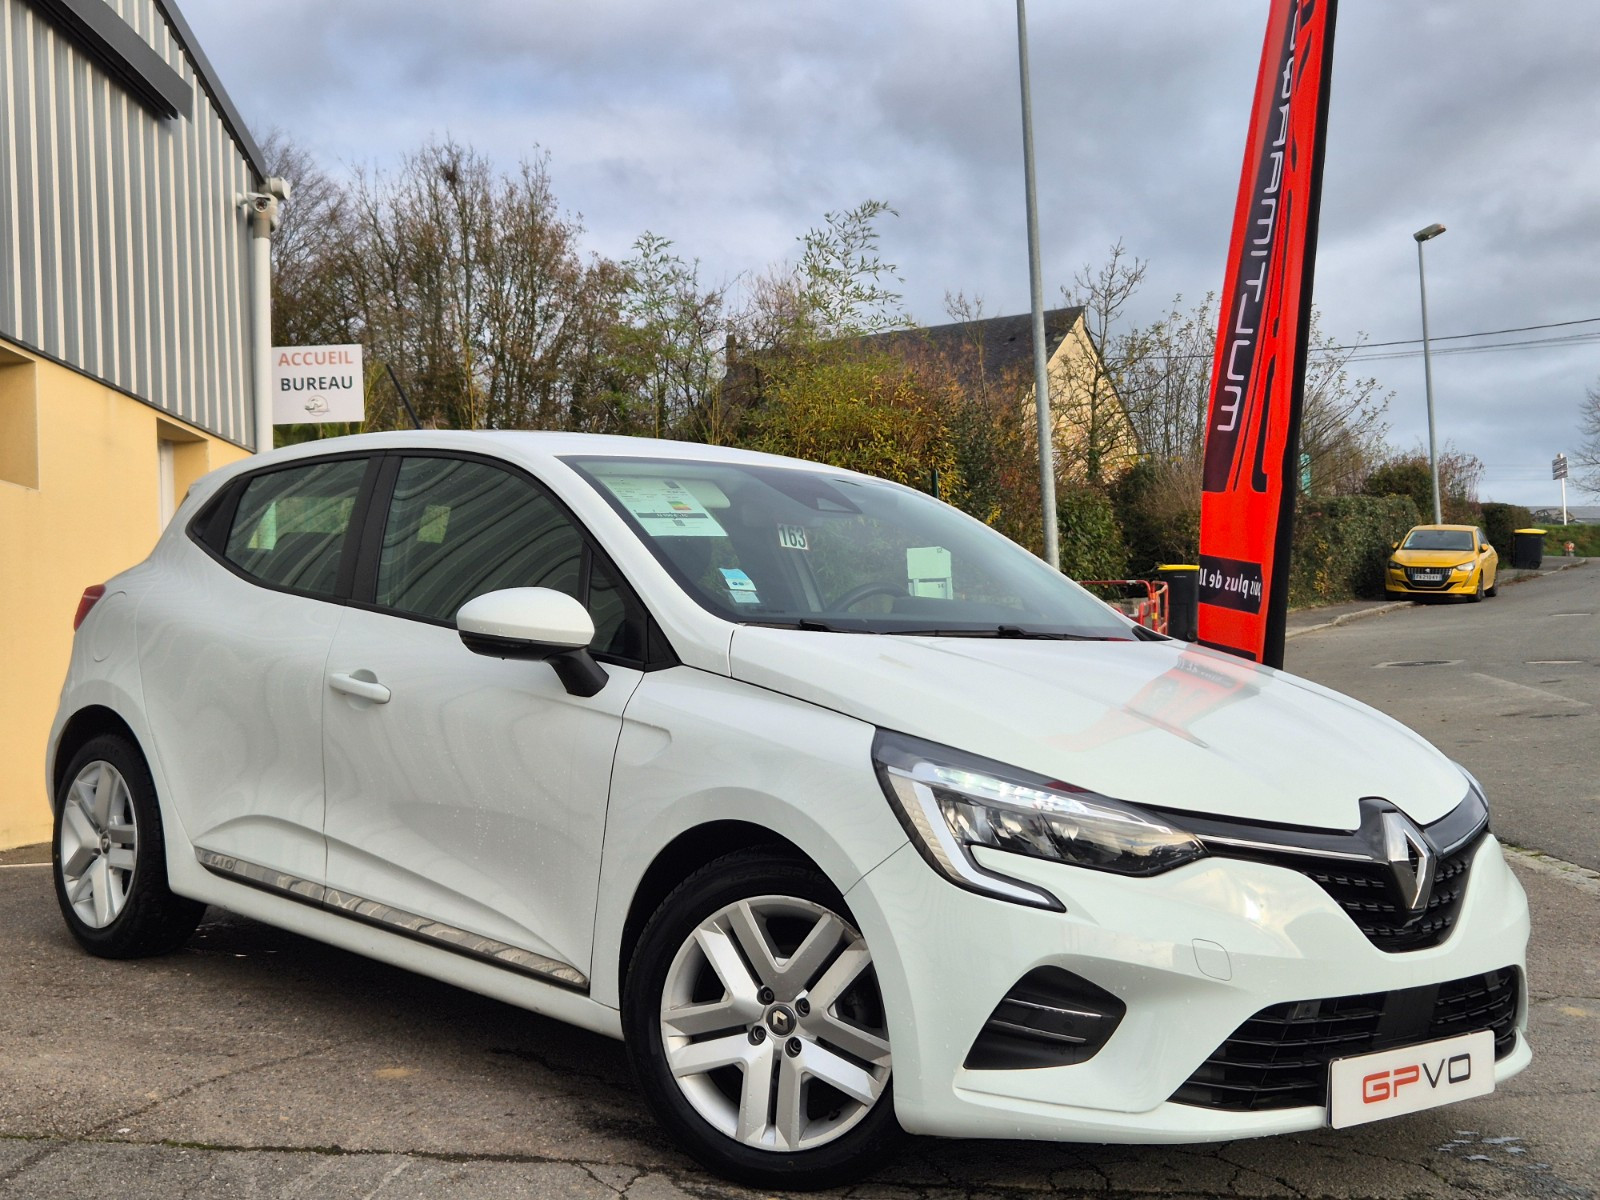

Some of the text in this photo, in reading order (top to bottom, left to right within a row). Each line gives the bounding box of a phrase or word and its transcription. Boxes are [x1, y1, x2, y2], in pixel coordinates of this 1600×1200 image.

[278, 351, 353, 367] ACCUEIL
[280, 376, 353, 391] BUREAU
[779, 525, 806, 548] 163
[1362, 1053, 1471, 1104] GPVO
